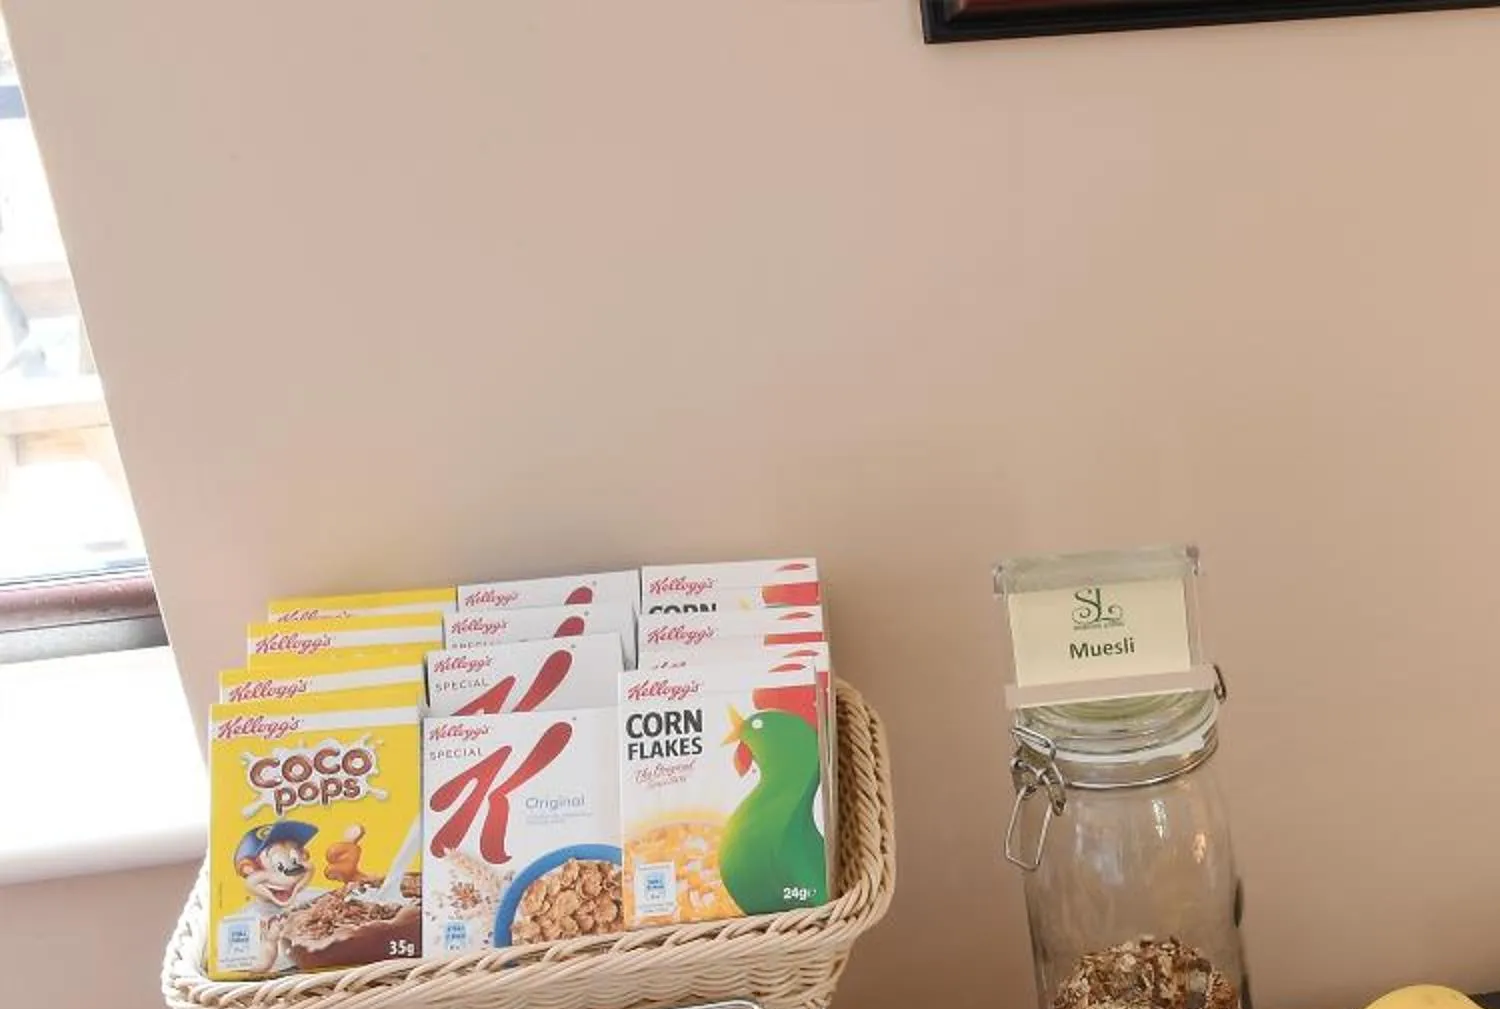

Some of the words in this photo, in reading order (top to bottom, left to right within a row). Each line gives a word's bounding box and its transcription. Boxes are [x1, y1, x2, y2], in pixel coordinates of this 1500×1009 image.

[649, 576, 718, 594] Kellogg's
[256, 634, 333, 654] Kellogg's
[647, 626, 717, 645] Kellogg's
[1070, 637, 1134, 659] Muesli
[228, 680, 308, 702] Kellogg's
[435, 678, 490, 692] SPECIAL
[628, 680, 703, 700] Kellogg's
[217, 716, 301, 740] Kellogg's
[429, 723, 490, 741] Kellogg's
[625, 709, 703, 739] CORN
[429, 747, 483, 760] SPECIAL
[627, 737, 703, 761] FLAKES
[250, 748, 373, 788] COCO
[525, 793, 585, 810] Original
[389, 941, 415, 957] 35g
